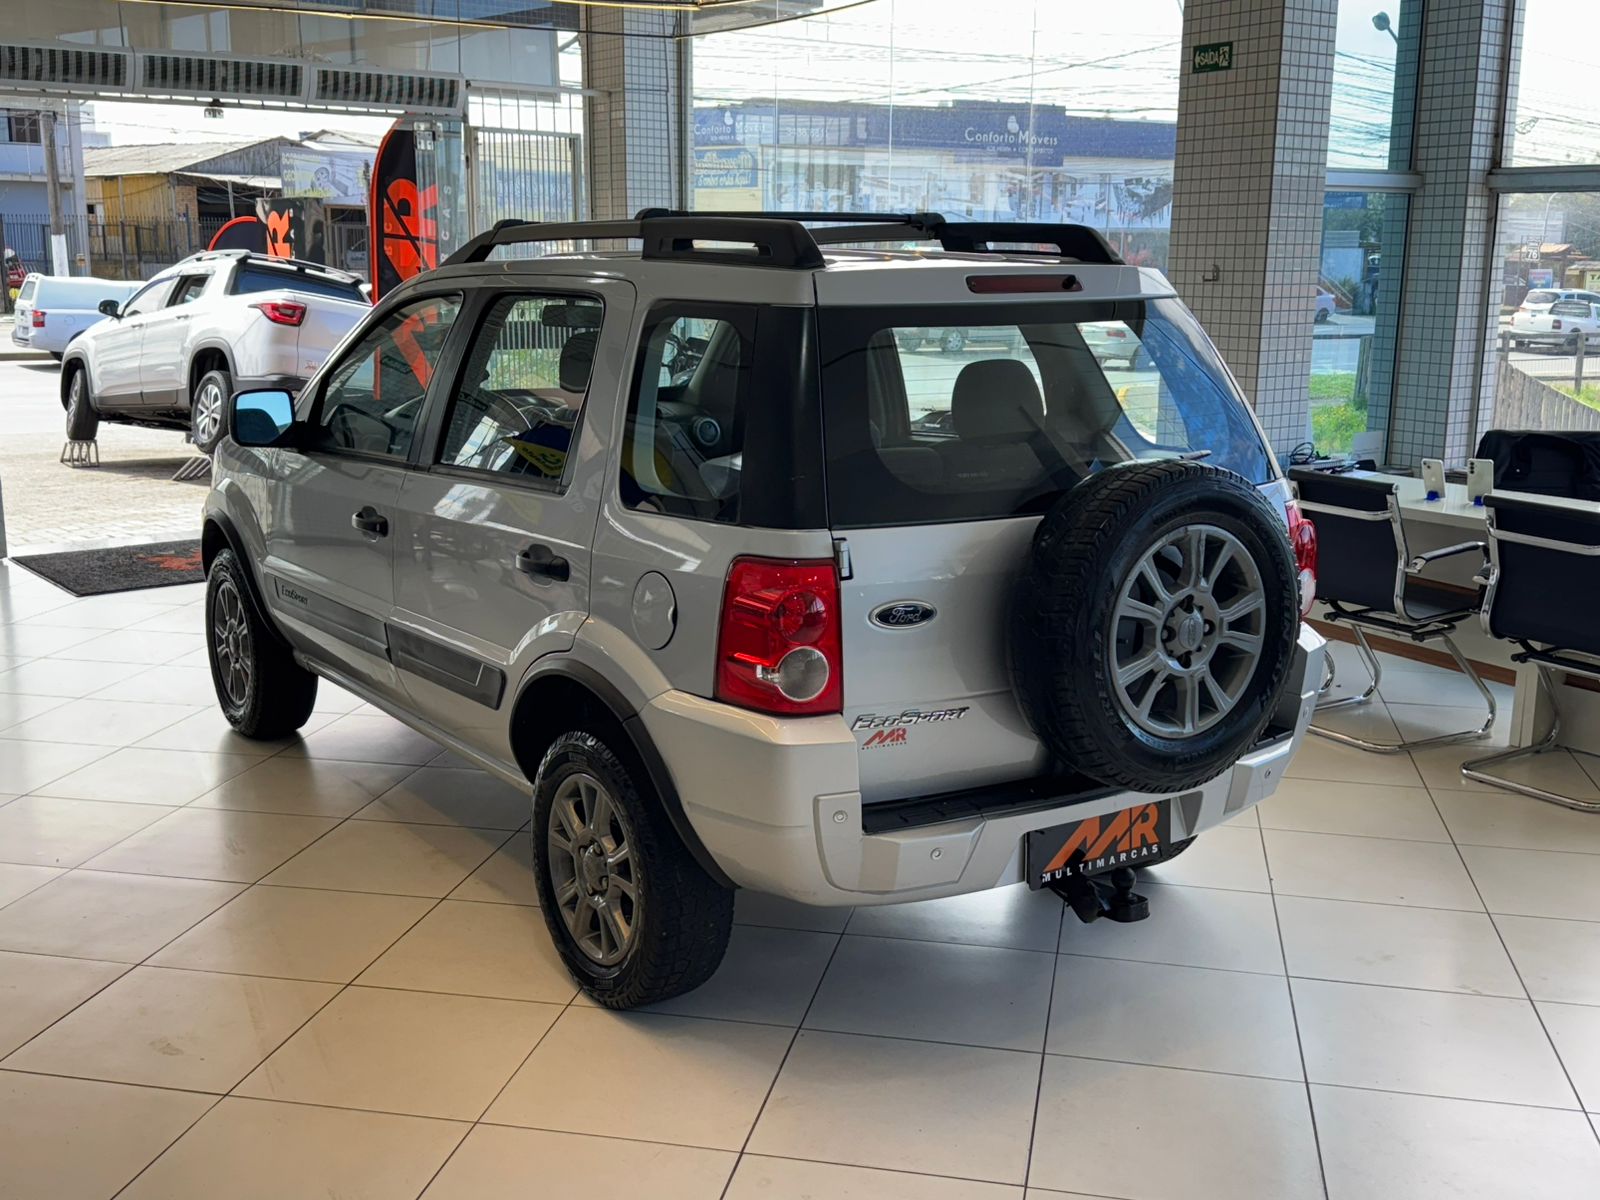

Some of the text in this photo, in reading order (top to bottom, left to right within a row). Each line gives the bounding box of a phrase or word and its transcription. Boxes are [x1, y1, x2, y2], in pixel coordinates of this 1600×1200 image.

[693, 124, 731, 135] Conforto
[964, 127, 1015, 143] Conforto
[888, 606, 923, 623] Ford
[1042, 844, 1159, 883] MULTIMARCAS
